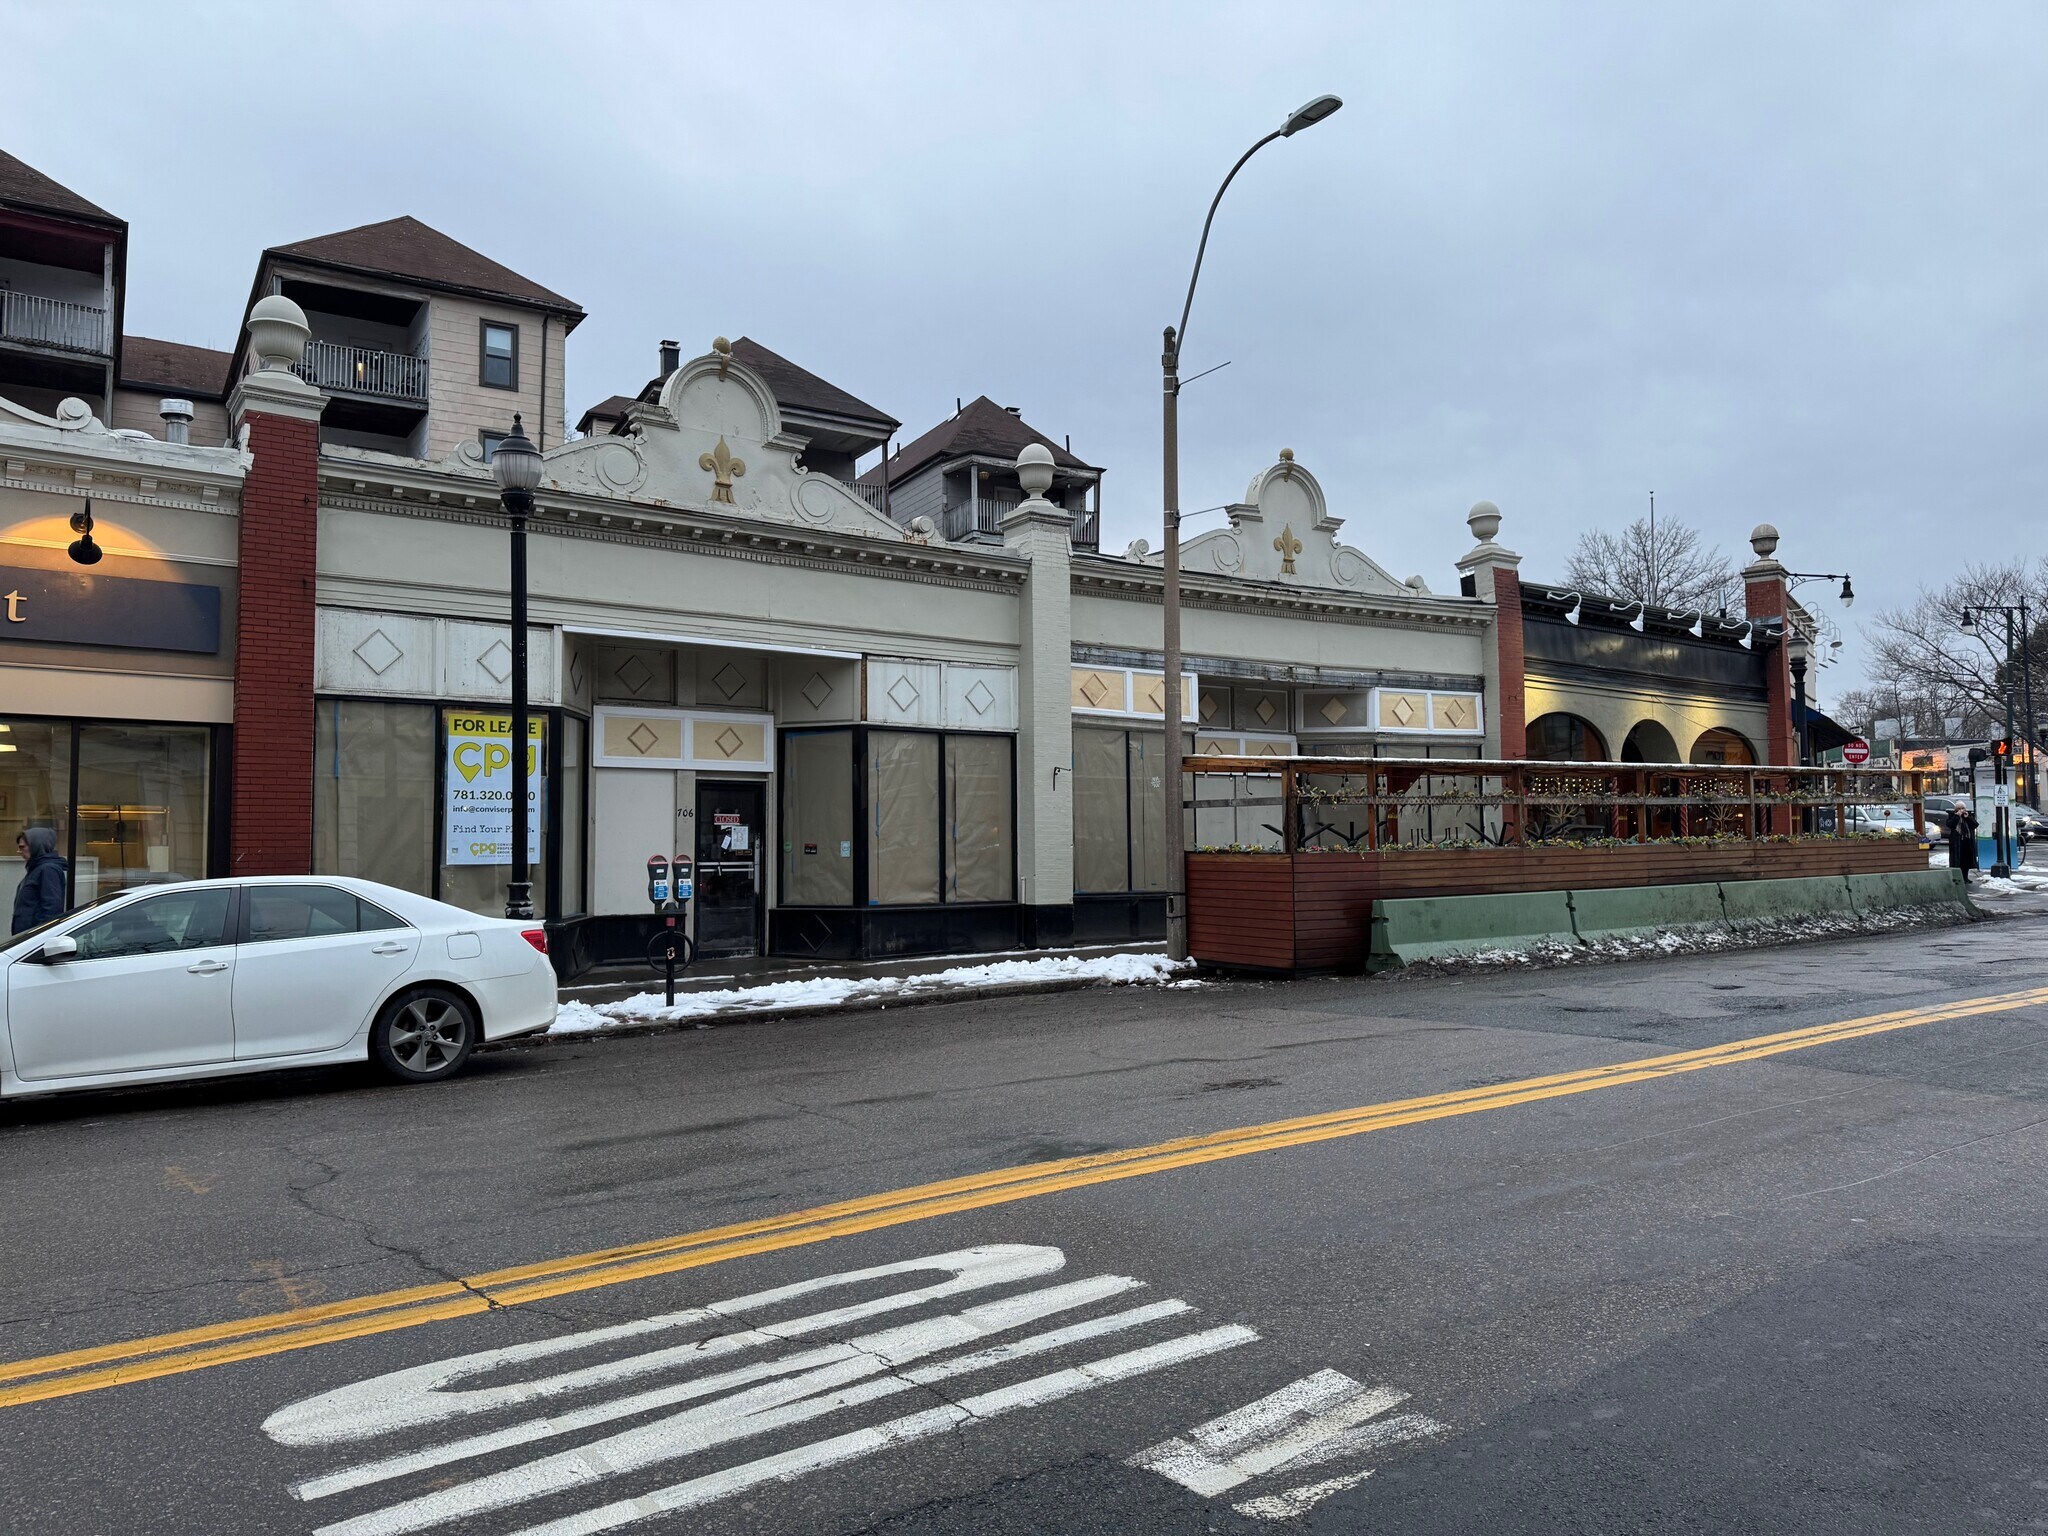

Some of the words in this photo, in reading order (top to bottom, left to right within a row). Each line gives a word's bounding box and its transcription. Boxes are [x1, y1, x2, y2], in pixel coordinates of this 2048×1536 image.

[453, 719, 486, 732] FOR
[490, 721, 537, 734] LEE
[453, 790, 536, 801] 781.320.00
[453, 805, 536, 814] info@conviserpm
[677, 808, 694, 817] 706
[714, 816, 740, 824] CLOSED
[453, 825, 477, 833] Find
[479, 825, 503, 833] Your
